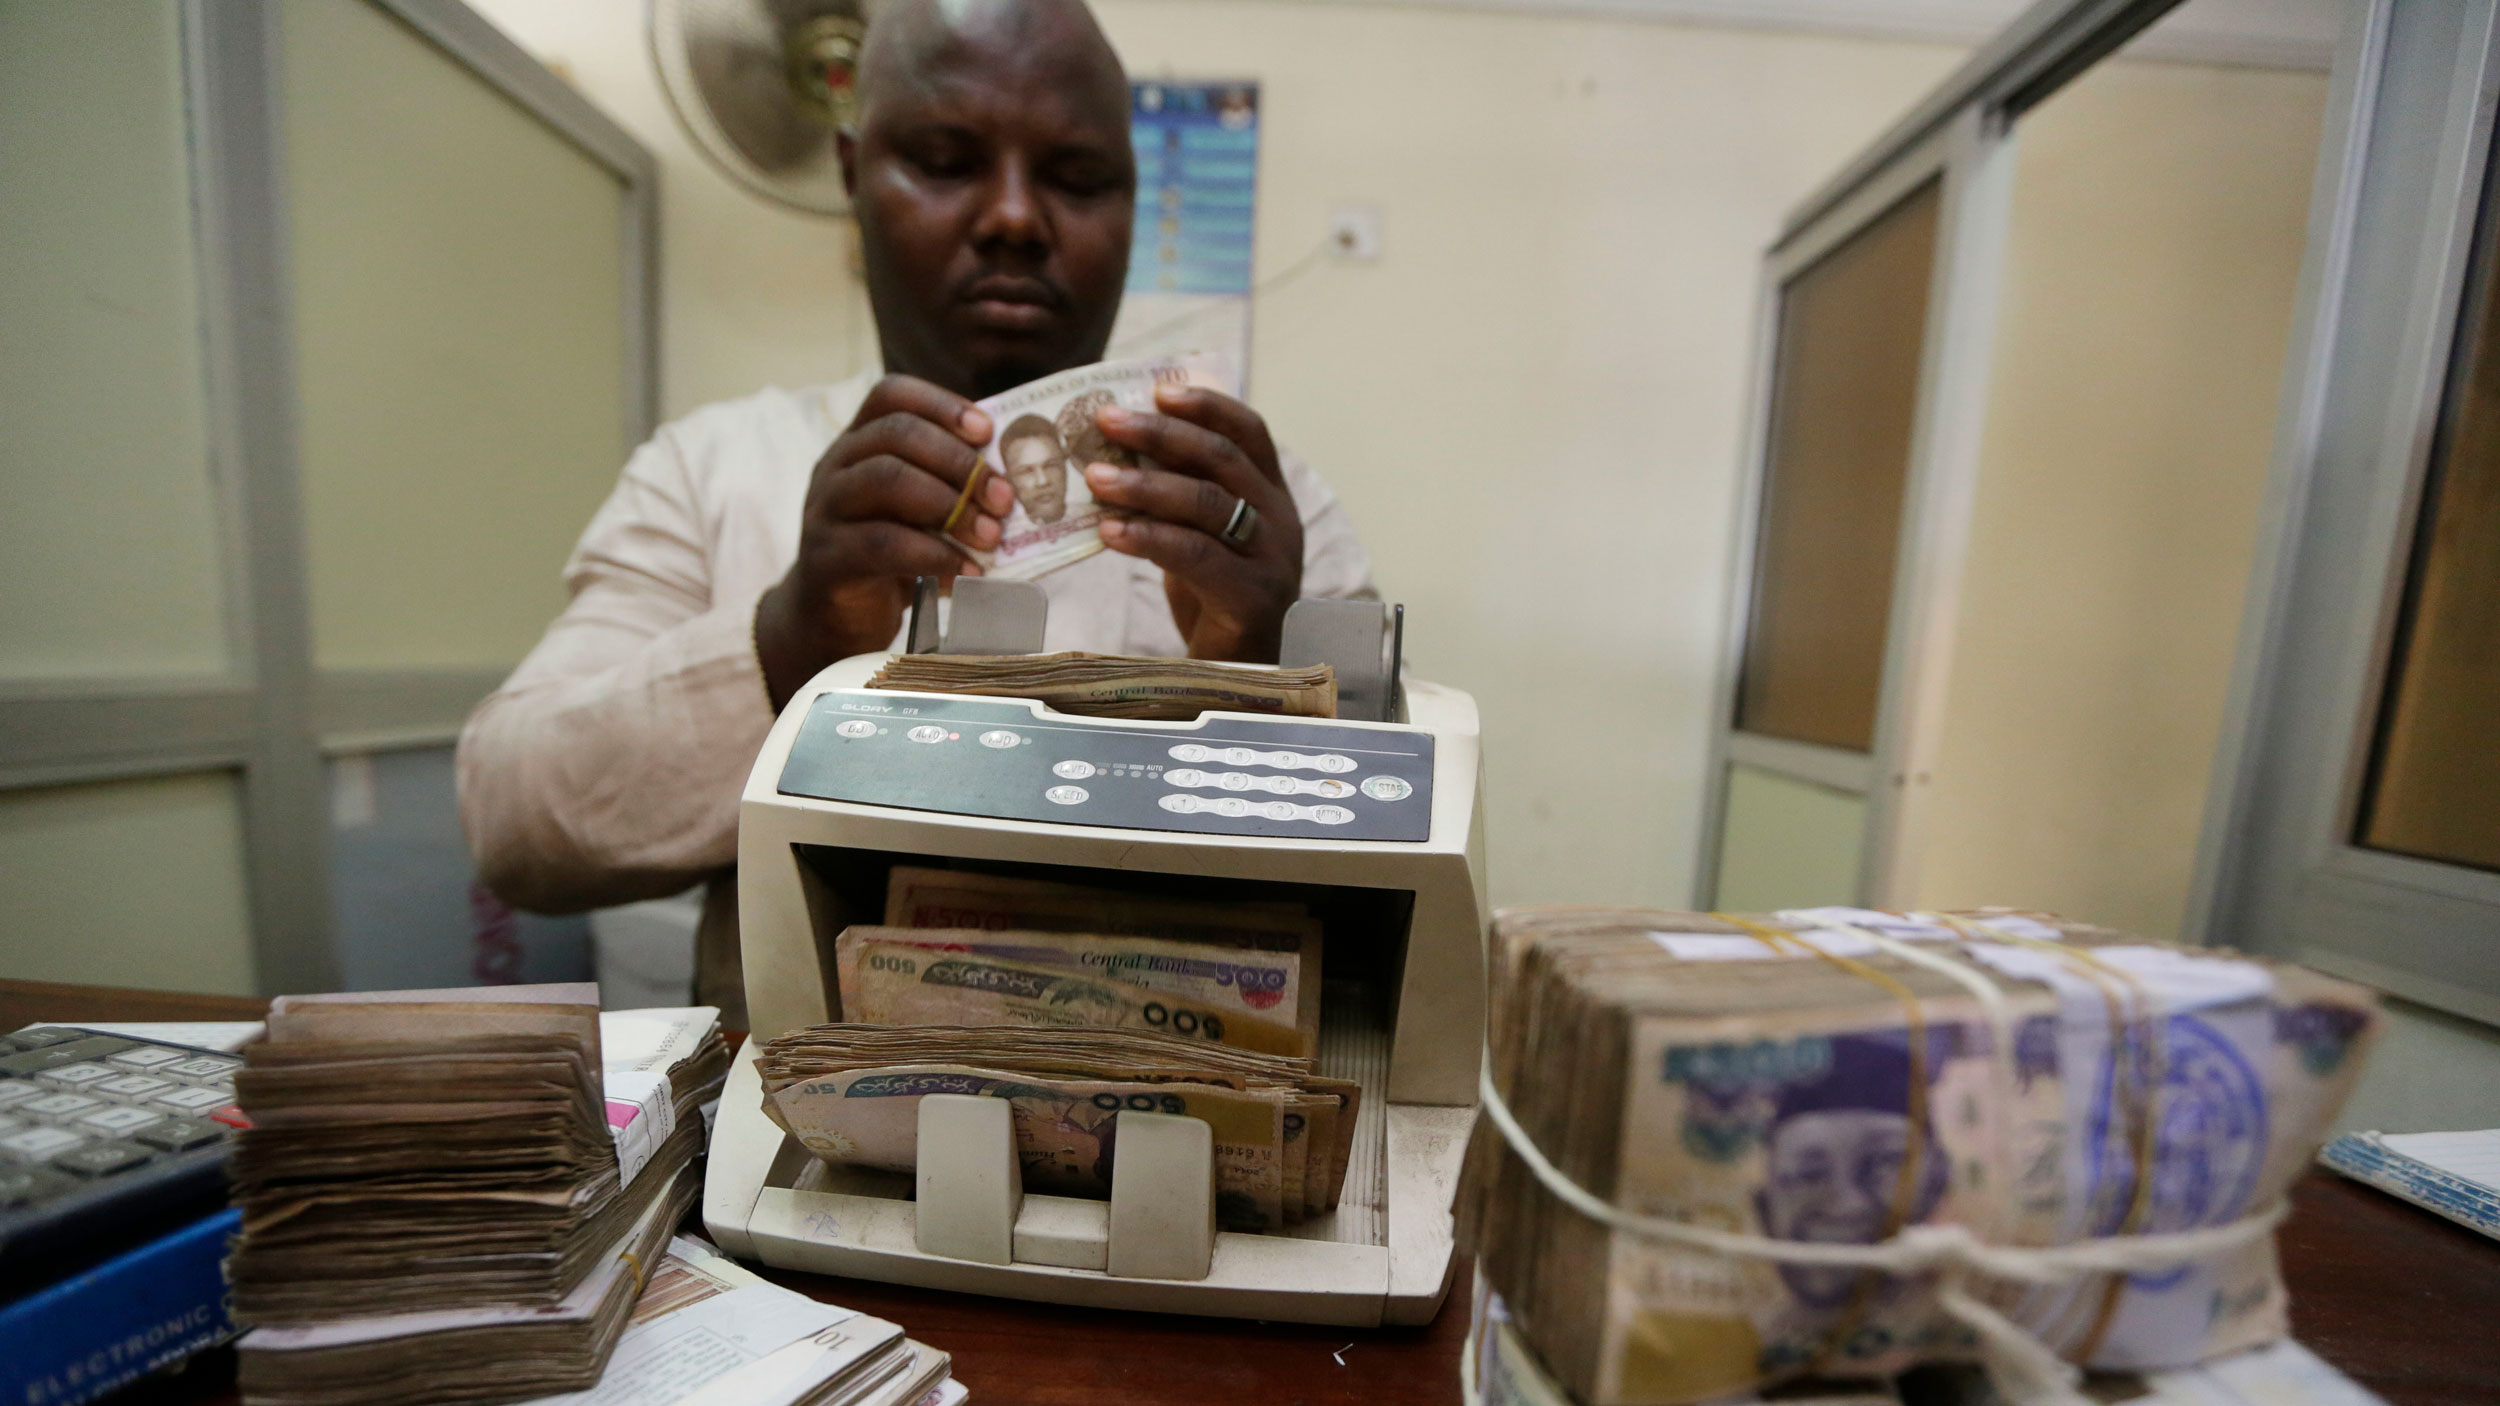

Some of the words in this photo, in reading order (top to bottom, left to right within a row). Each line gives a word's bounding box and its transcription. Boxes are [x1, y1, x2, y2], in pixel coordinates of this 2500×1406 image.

[1090, 686, 1146, 697] Central
[1154, 686, 1194, 697] Bank
[841, 703, 893, 713] GLORY
[1146, 763, 1163, 772] AUTO
[1080, 950, 1143, 971] Central
[1148, 955, 1191, 976] Bank
[1215, 962, 1288, 991] 500
[26, 1303, 212, 1405] ELECTRONIC
